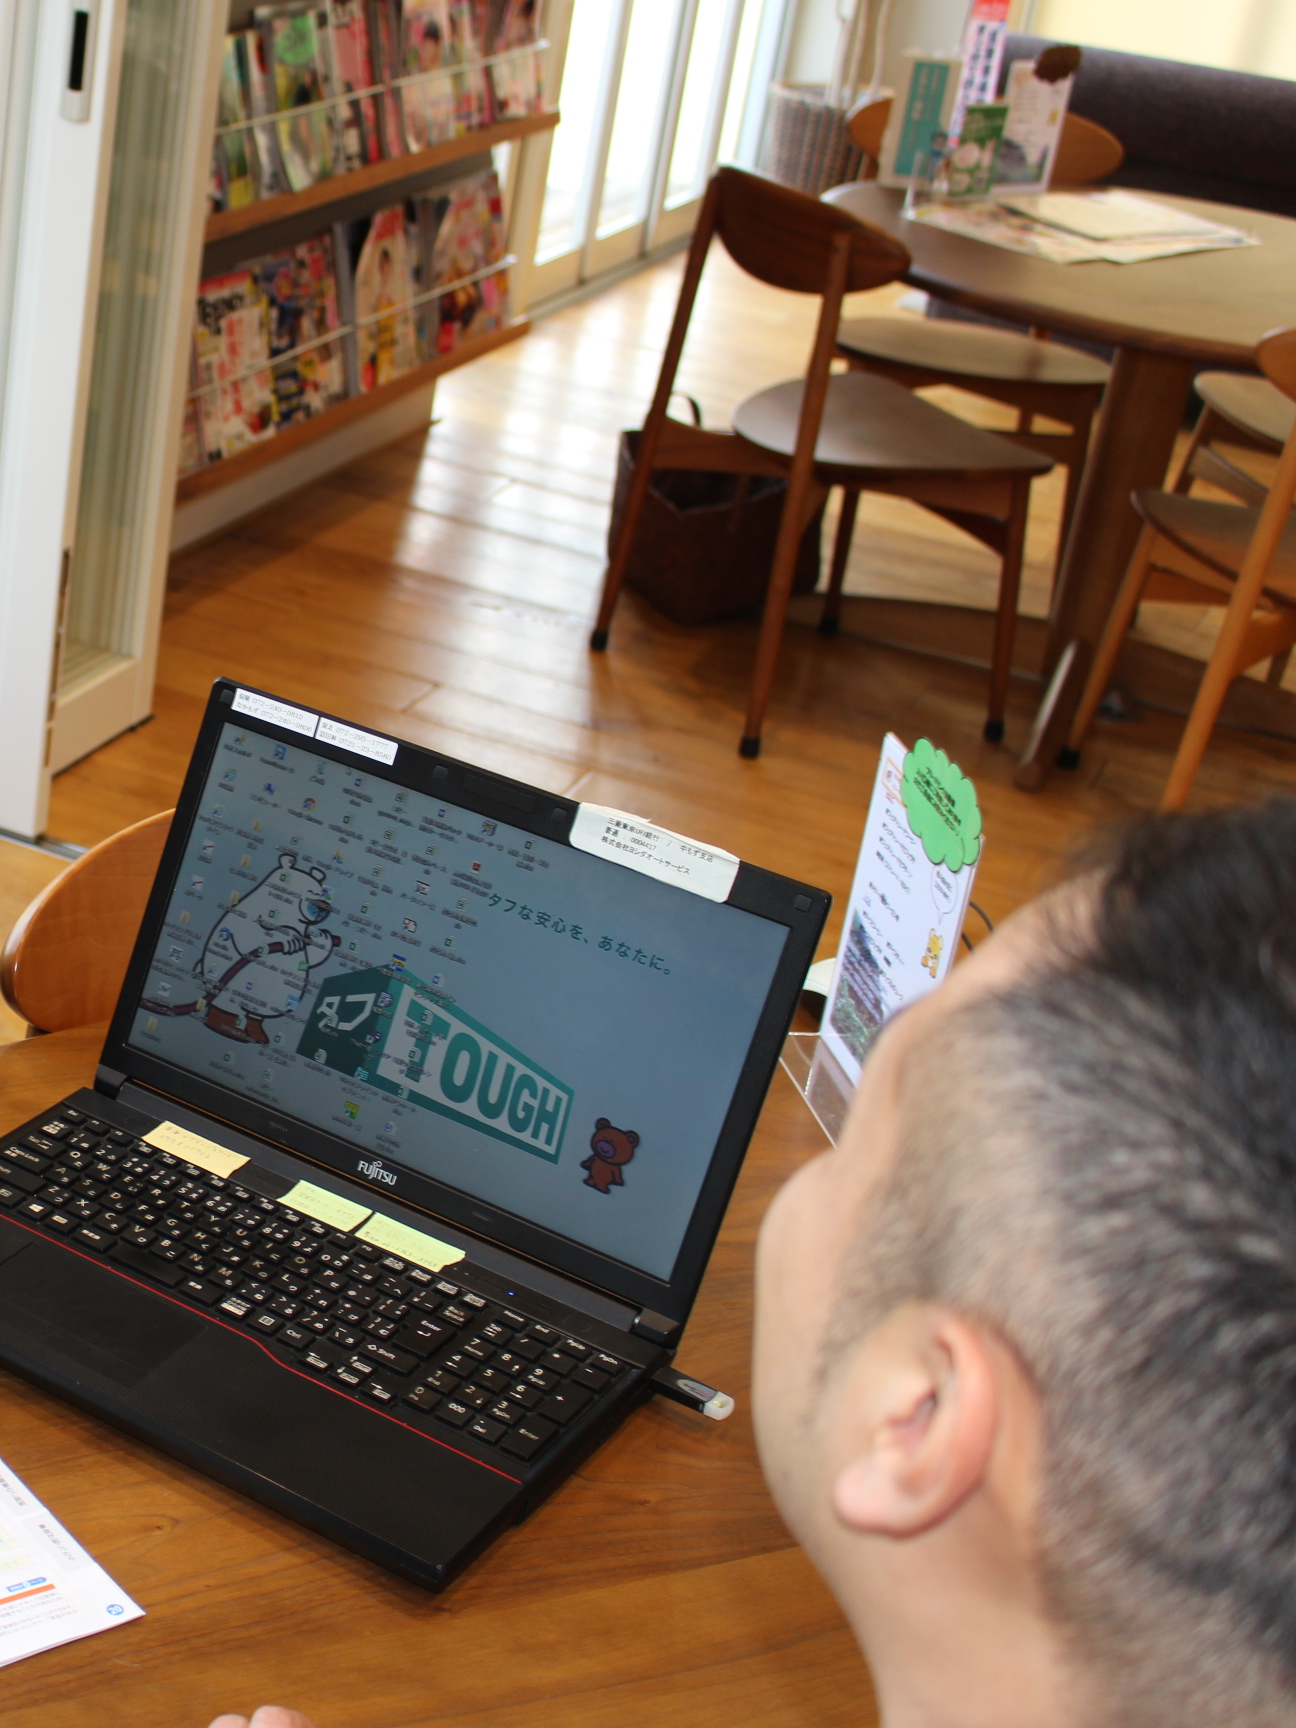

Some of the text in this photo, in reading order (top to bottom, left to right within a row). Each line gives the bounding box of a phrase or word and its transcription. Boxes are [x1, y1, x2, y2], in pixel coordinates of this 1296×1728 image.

[488, 892, 672, 977] タフな安心を、あなたに。
[407, 997, 563, 1151] TOUGH
[357, 1160, 397, 1186] FUJITSU
[109, 1605, 122, 1615] 20
